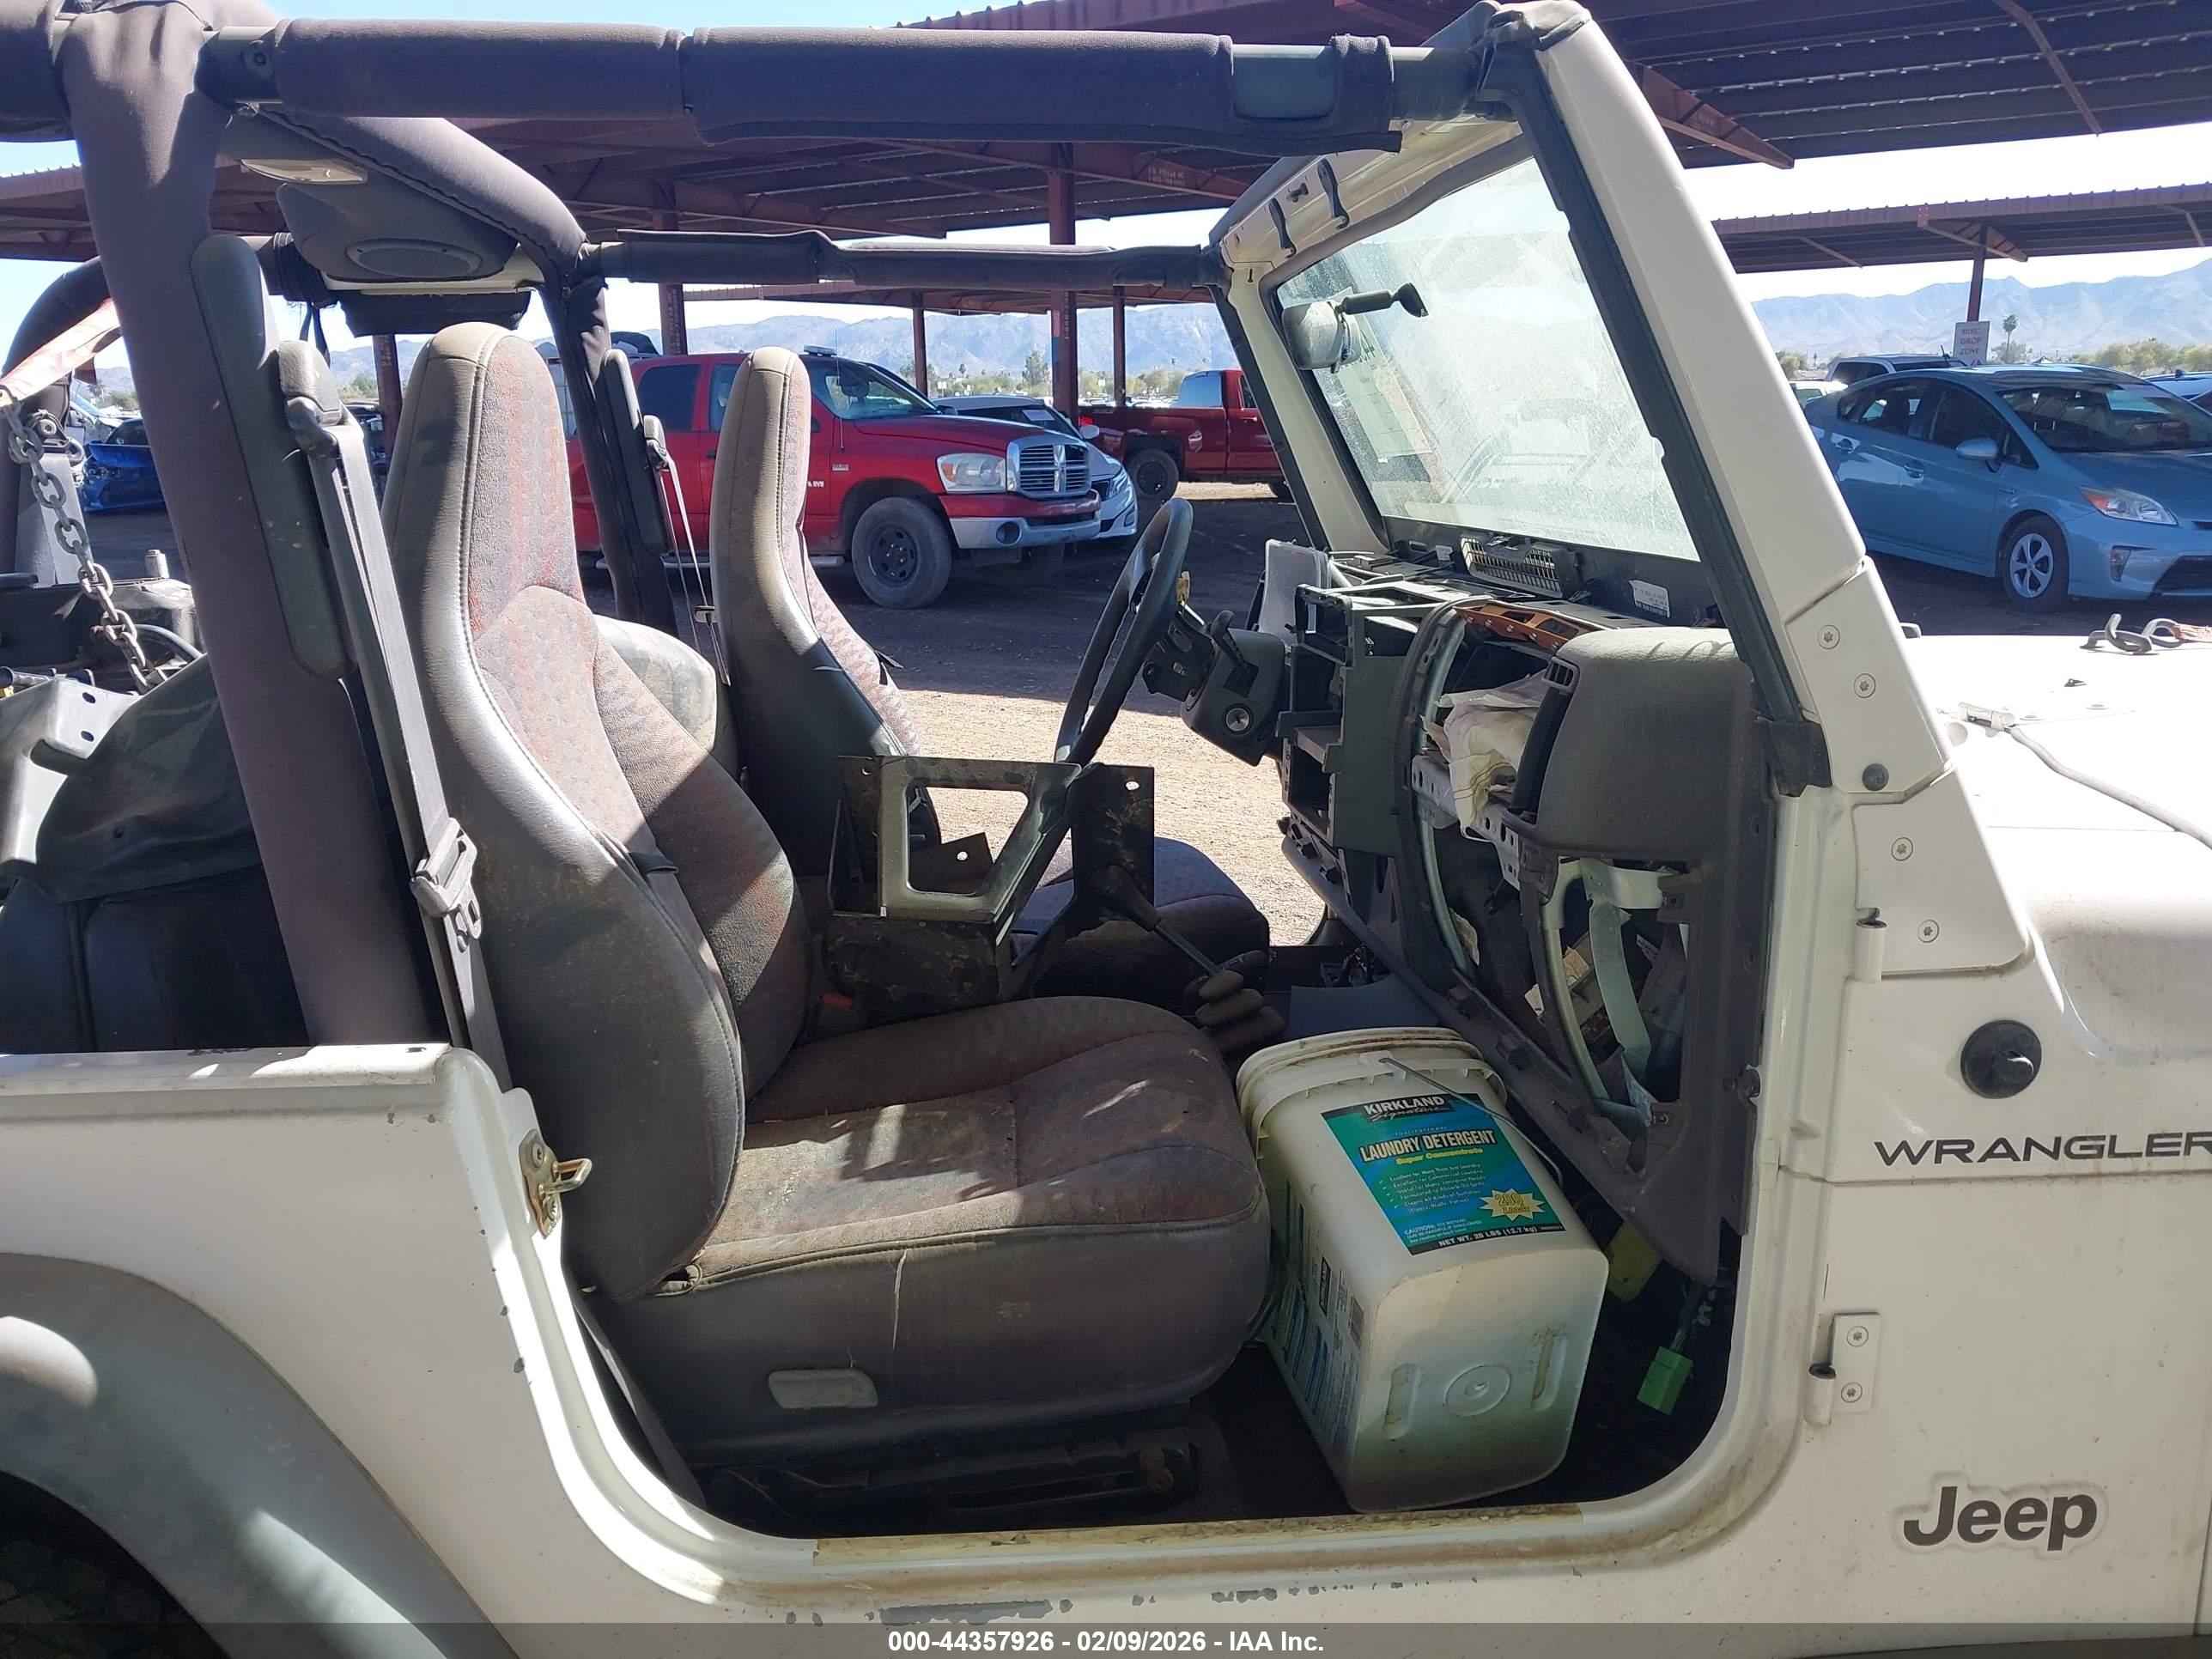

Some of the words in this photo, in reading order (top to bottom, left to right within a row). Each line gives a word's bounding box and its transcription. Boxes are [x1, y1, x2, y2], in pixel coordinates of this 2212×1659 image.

[1960, 347, 1979, 356] ZONE
[1364, 1096, 1444, 1115] KIRKLAND
[1370, 1106, 1450, 1122] Signature
[1359, 1136, 1421, 1162] LAUNDRY
[1422, 1130, 1496, 1150] DETERGENT
[1874, 1131, 2212, 1166] WRANGLER
[1396, 1155, 1424, 1165] Super
[1495, 1193, 1524, 1206] 200
[1438, 1237, 1455, 1247] NET
[1456, 1235, 1473, 1243] WT.
[1485, 1229, 1502, 1237] LBS
[1503, 1226, 1522, 1236] (12.7
[1903, 1486, 2098, 1552] Jeep
